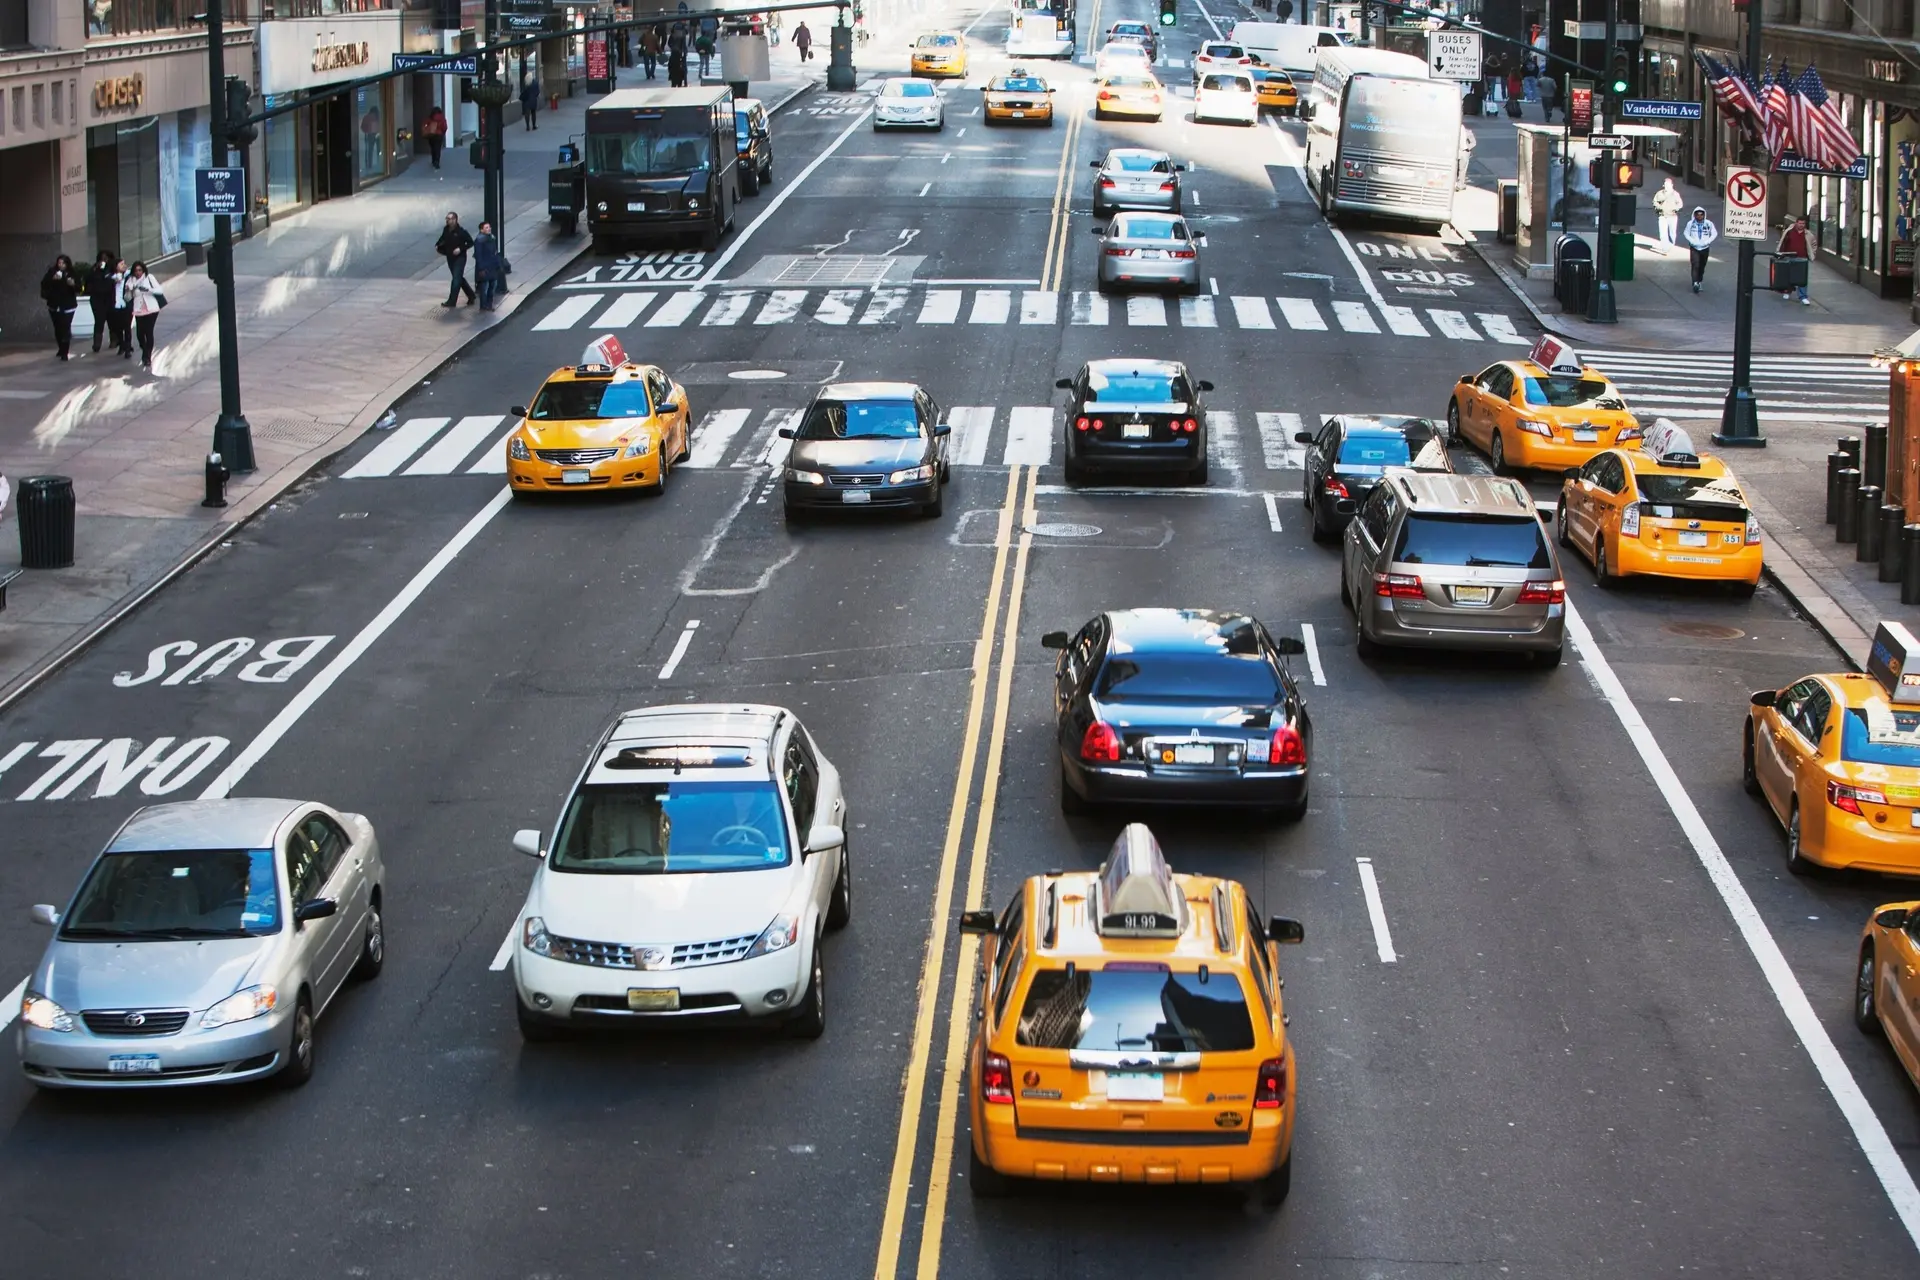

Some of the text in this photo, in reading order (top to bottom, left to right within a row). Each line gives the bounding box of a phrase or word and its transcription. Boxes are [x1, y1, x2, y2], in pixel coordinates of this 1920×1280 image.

[1438, 36, 1472, 44] BUSES
[1442, 46, 1468, 54] ONLY
[454, 60, 474, 70] Ave
[95, 77, 134, 108] CHASE
[1625, 103, 1700, 117] Vanderbilt Ave
[1613, 138, 1627, 146] WAY
[204, 193, 235, 202] Security
[205, 200, 236, 208] Camera
[1726, 227, 1740, 235] MON
[564, 264, 704, 283] ONLY
[1724, 534, 1741, 544] 351
[112, 635, 336, 687] BUS
